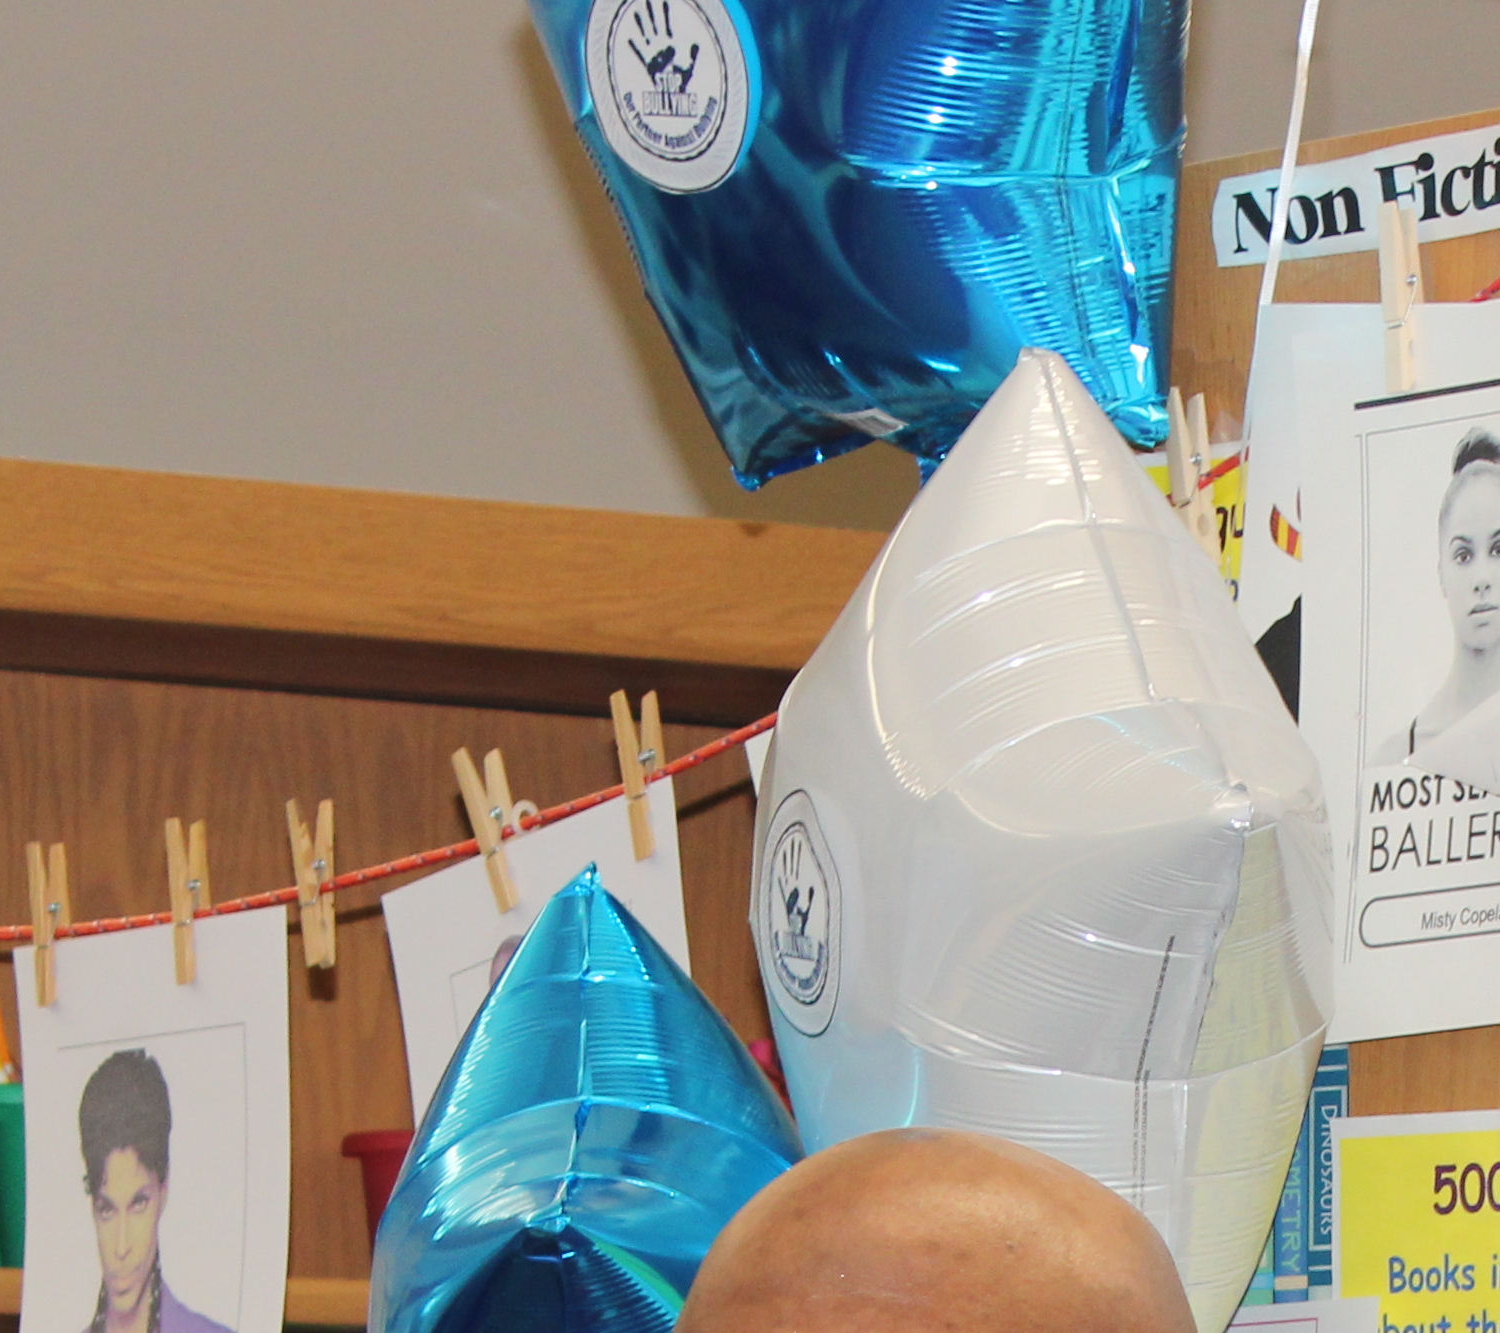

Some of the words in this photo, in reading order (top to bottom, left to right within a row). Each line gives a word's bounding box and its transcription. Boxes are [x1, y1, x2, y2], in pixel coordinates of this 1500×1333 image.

[1233, 185, 1366, 254] Non
[1368, 775, 1446, 814] MOST
[1420, 908, 1458, 931] Misty
[1387, 1254, 1477, 1294] Books
